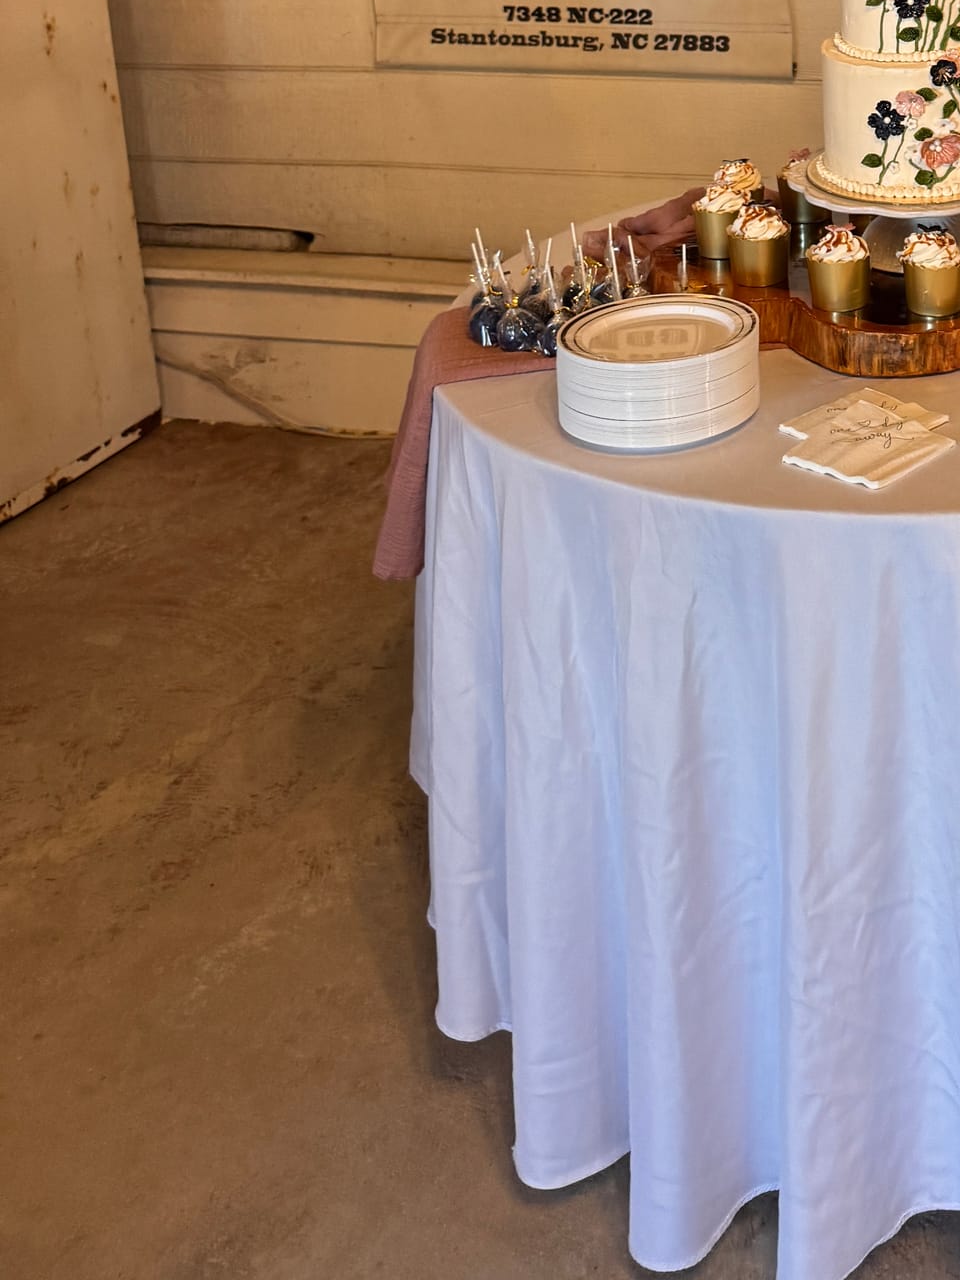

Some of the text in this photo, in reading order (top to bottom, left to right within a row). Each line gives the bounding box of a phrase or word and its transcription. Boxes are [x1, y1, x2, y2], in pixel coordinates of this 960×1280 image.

[503, 5, 562, 23] 7348
[430, 27, 730, 53] Stantonsburg, NC 27883
